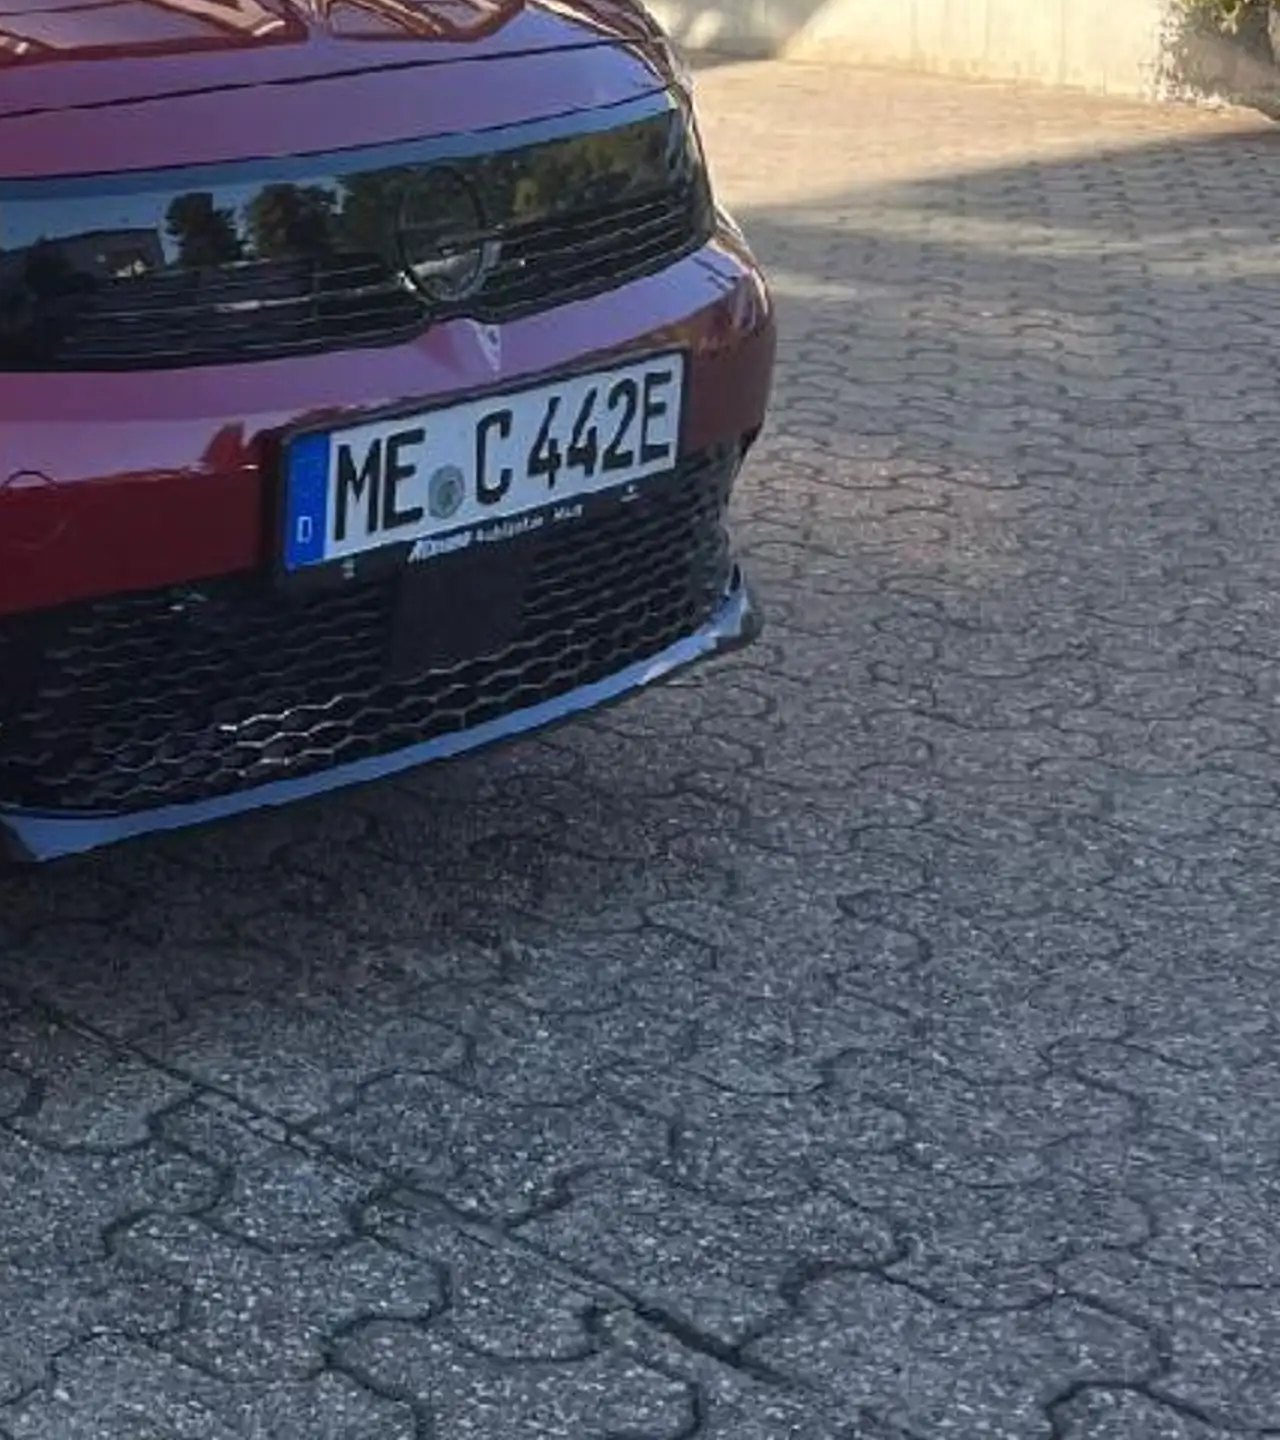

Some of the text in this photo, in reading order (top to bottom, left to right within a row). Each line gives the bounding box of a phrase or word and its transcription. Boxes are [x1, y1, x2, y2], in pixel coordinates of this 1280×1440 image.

[334, 428, 426, 541] ME
[475, 409, 513, 505] C
[527, 370, 672, 490] 442E
[297, 516, 312, 544] D
